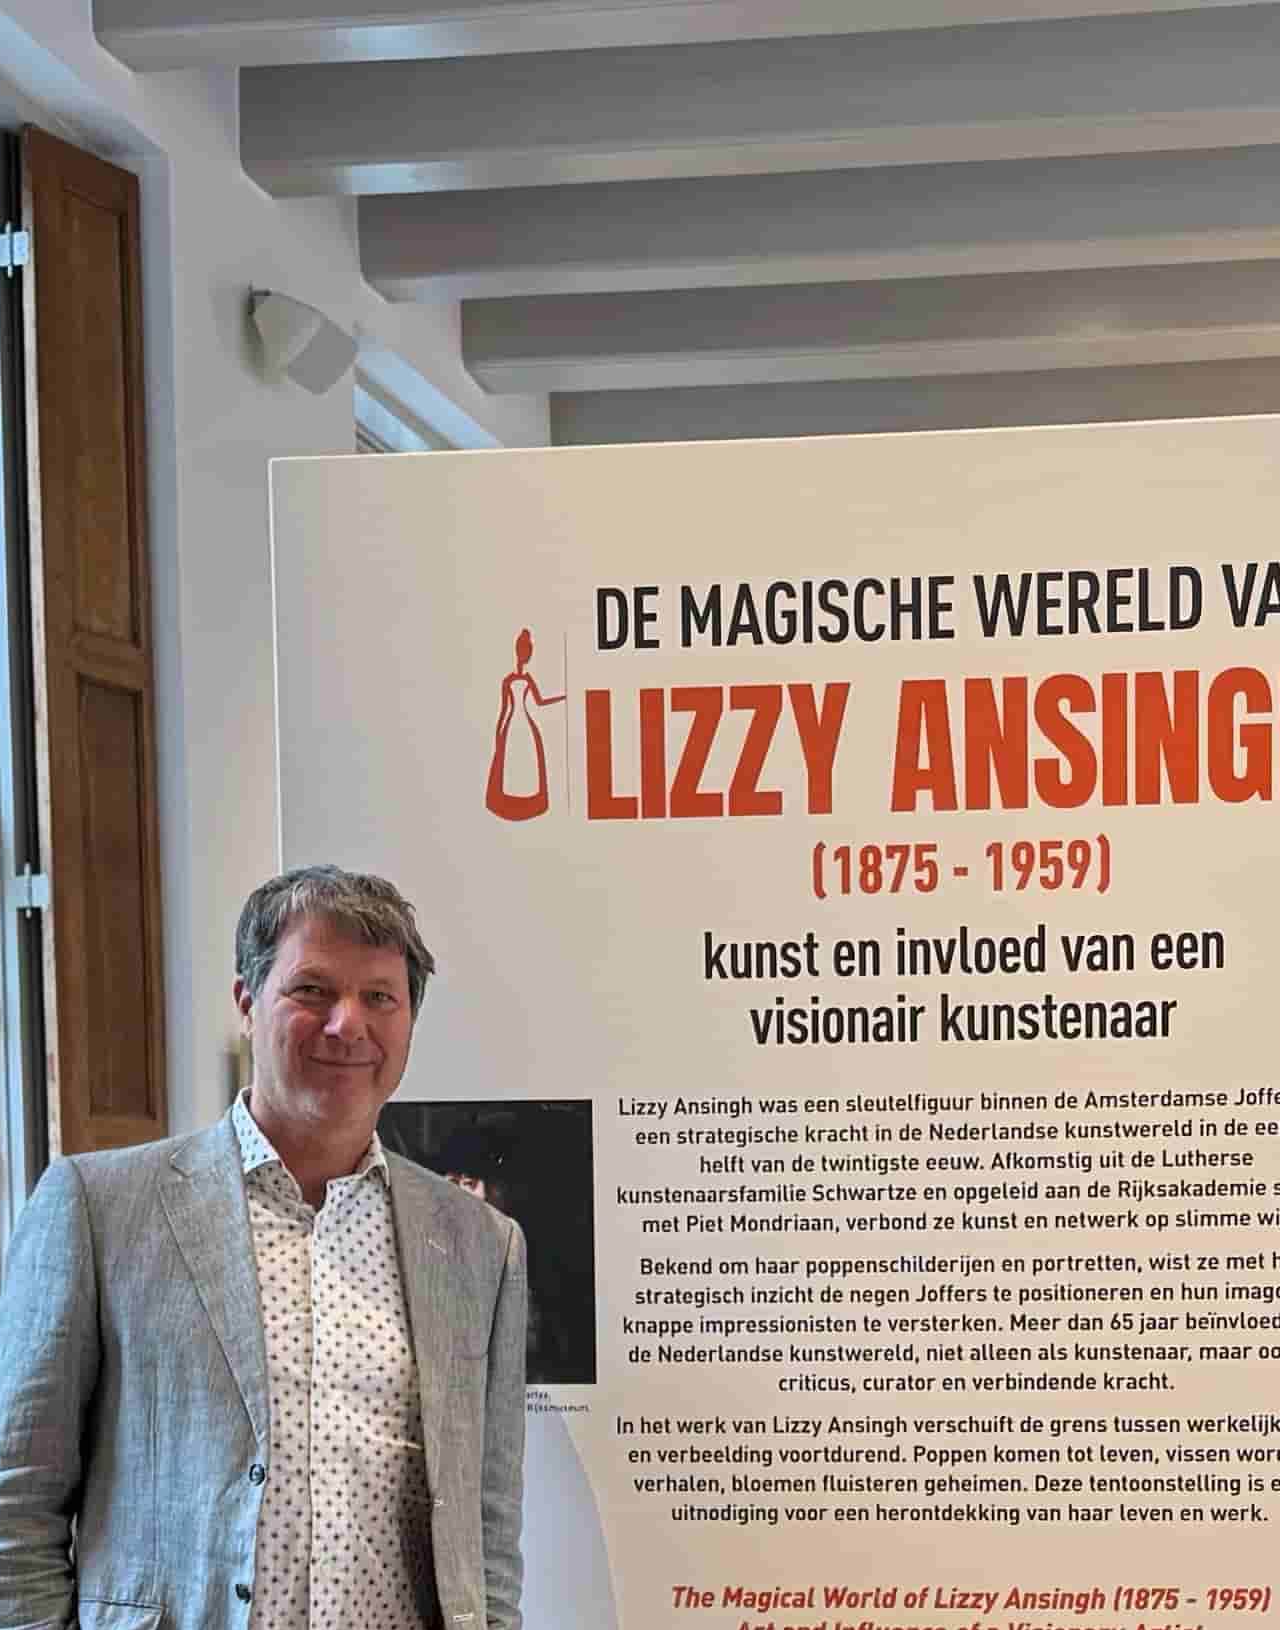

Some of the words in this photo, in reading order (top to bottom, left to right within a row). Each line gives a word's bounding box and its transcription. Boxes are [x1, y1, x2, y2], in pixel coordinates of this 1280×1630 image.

[597, 587, 659, 649] DE
[681, 576, 954, 647] MAGISCHE
[974, 567, 1202, 637] WERELD
[586, 683, 850, 820] LIZZY
[814, 842, 937, 899] (1875
[987, 835, 1109, 893] 1959)
[705, 932, 819, 979] kunst
[834, 940, 879, 976] en
[897, 925, 1045, 975] invloed
[1062, 935, 1133, 971] van
[1151, 932, 1223, 969] een
[750, 995, 925, 1044] visionair
[941, 994, 1177, 1041] kunstenaar
[619, 1098, 668, 1120] Lizzy
[673, 1096, 752, 1119] Ansingh
[758, 1099, 798, 1114] was
[804, 1096, 839, 1113] een
[846, 1093, 975, 1116] sleutelfiguur
[981, 1092, 1047, 1111] binnen
[1054, 1090, 1078, 1109] de
[1084, 1089, 1228, 1109] Amsterdamse
[635, 1131, 670, 1144] een
[677, 1125, 799, 1148] strategische
[805, 1124, 869, 1143] kracht
[875, 1124, 892, 1142] in
[899, 1123, 922, 1141] de
[929, 1120, 1059, 1141] Nederlandse
[1065, 1118, 1192, 1139] kunstwereld
[1200, 1118, 1217, 1136] in
[1224, 1118, 1248, 1136] de
[700, 1155, 744, 1174] helft
[750, 1160, 784, 1173] van
[792, 1153, 815, 1172] de
[821, 1153, 920, 1176] twintigste
[926, 1156, 984, 1171] eeuw.
[990, 1150, 1092, 1173] Afkomstig
[1100, 1150, 1125, 1168] uit
[1131, 1150, 1155, 1168] de
[1162, 1148, 1254, 1167] Lutherse
[617, 1184, 806, 1204] kunstenaarsfamilie
[812, 1184, 917, 1202] Schwartze
[923, 1187, 947, 1200] en
[953, 1181, 1038, 1205] opgeleid
[1045, 1185, 1080, 1200] aan
[1088, 1180, 1111, 1198] de
[1118, 1177, 1267, 1202] Rijksakademie
[642, 1216, 680, 1232] met
[687, 1213, 723, 1232] Piet
[730, 1213, 840, 1234] Mondriaan,
[846, 1211, 927, 1231] verbond
[933, 1216, 955, 1230] ze
[962, 1211, 1018, 1230] kunst
[1024, 1216, 1048, 1229] en
[1055, 1209, 1139, 1229] netwerk
[1145, 1214, 1168, 1232] op
[1176, 1209, 1251, 1227] slimme
[778, 1373, 856, 1394] criticus,
[863, 1374, 936, 1392] curator
[942, 1377, 966, 1391] en
[972, 1372, 1096, 1391] verbindende
[1104, 1371, 1175, 1390] kracht.
[672, 1504, 778, 1525] uitnodiging
[784, 1504, 829, 1521] voor
[834, 1508, 869, 1521] een
[876, 1504, 1020, 1526] herontdekking
[1026, 1508, 1061, 1521] van
[1069, 1504, 1114, 1522] haar
[1120, 1504, 1173, 1522] leven
[1180, 1508, 1204, 1521] en
[1210, 1504, 1268, 1522] werk.
[672, 1586, 715, 1608] The
[722, 1586, 815, 1613] Magical
[824, 1586, 898, 1608] World
[904, 1586, 930, 1608] of
[934, 1586, 1000, 1615] Lizzy
[1003, 1587, 1106, 1615] Ansingh
[1113, 1586, 1180, 1612] (1875
[1206, 1586, 1272, 1613] 1959)
